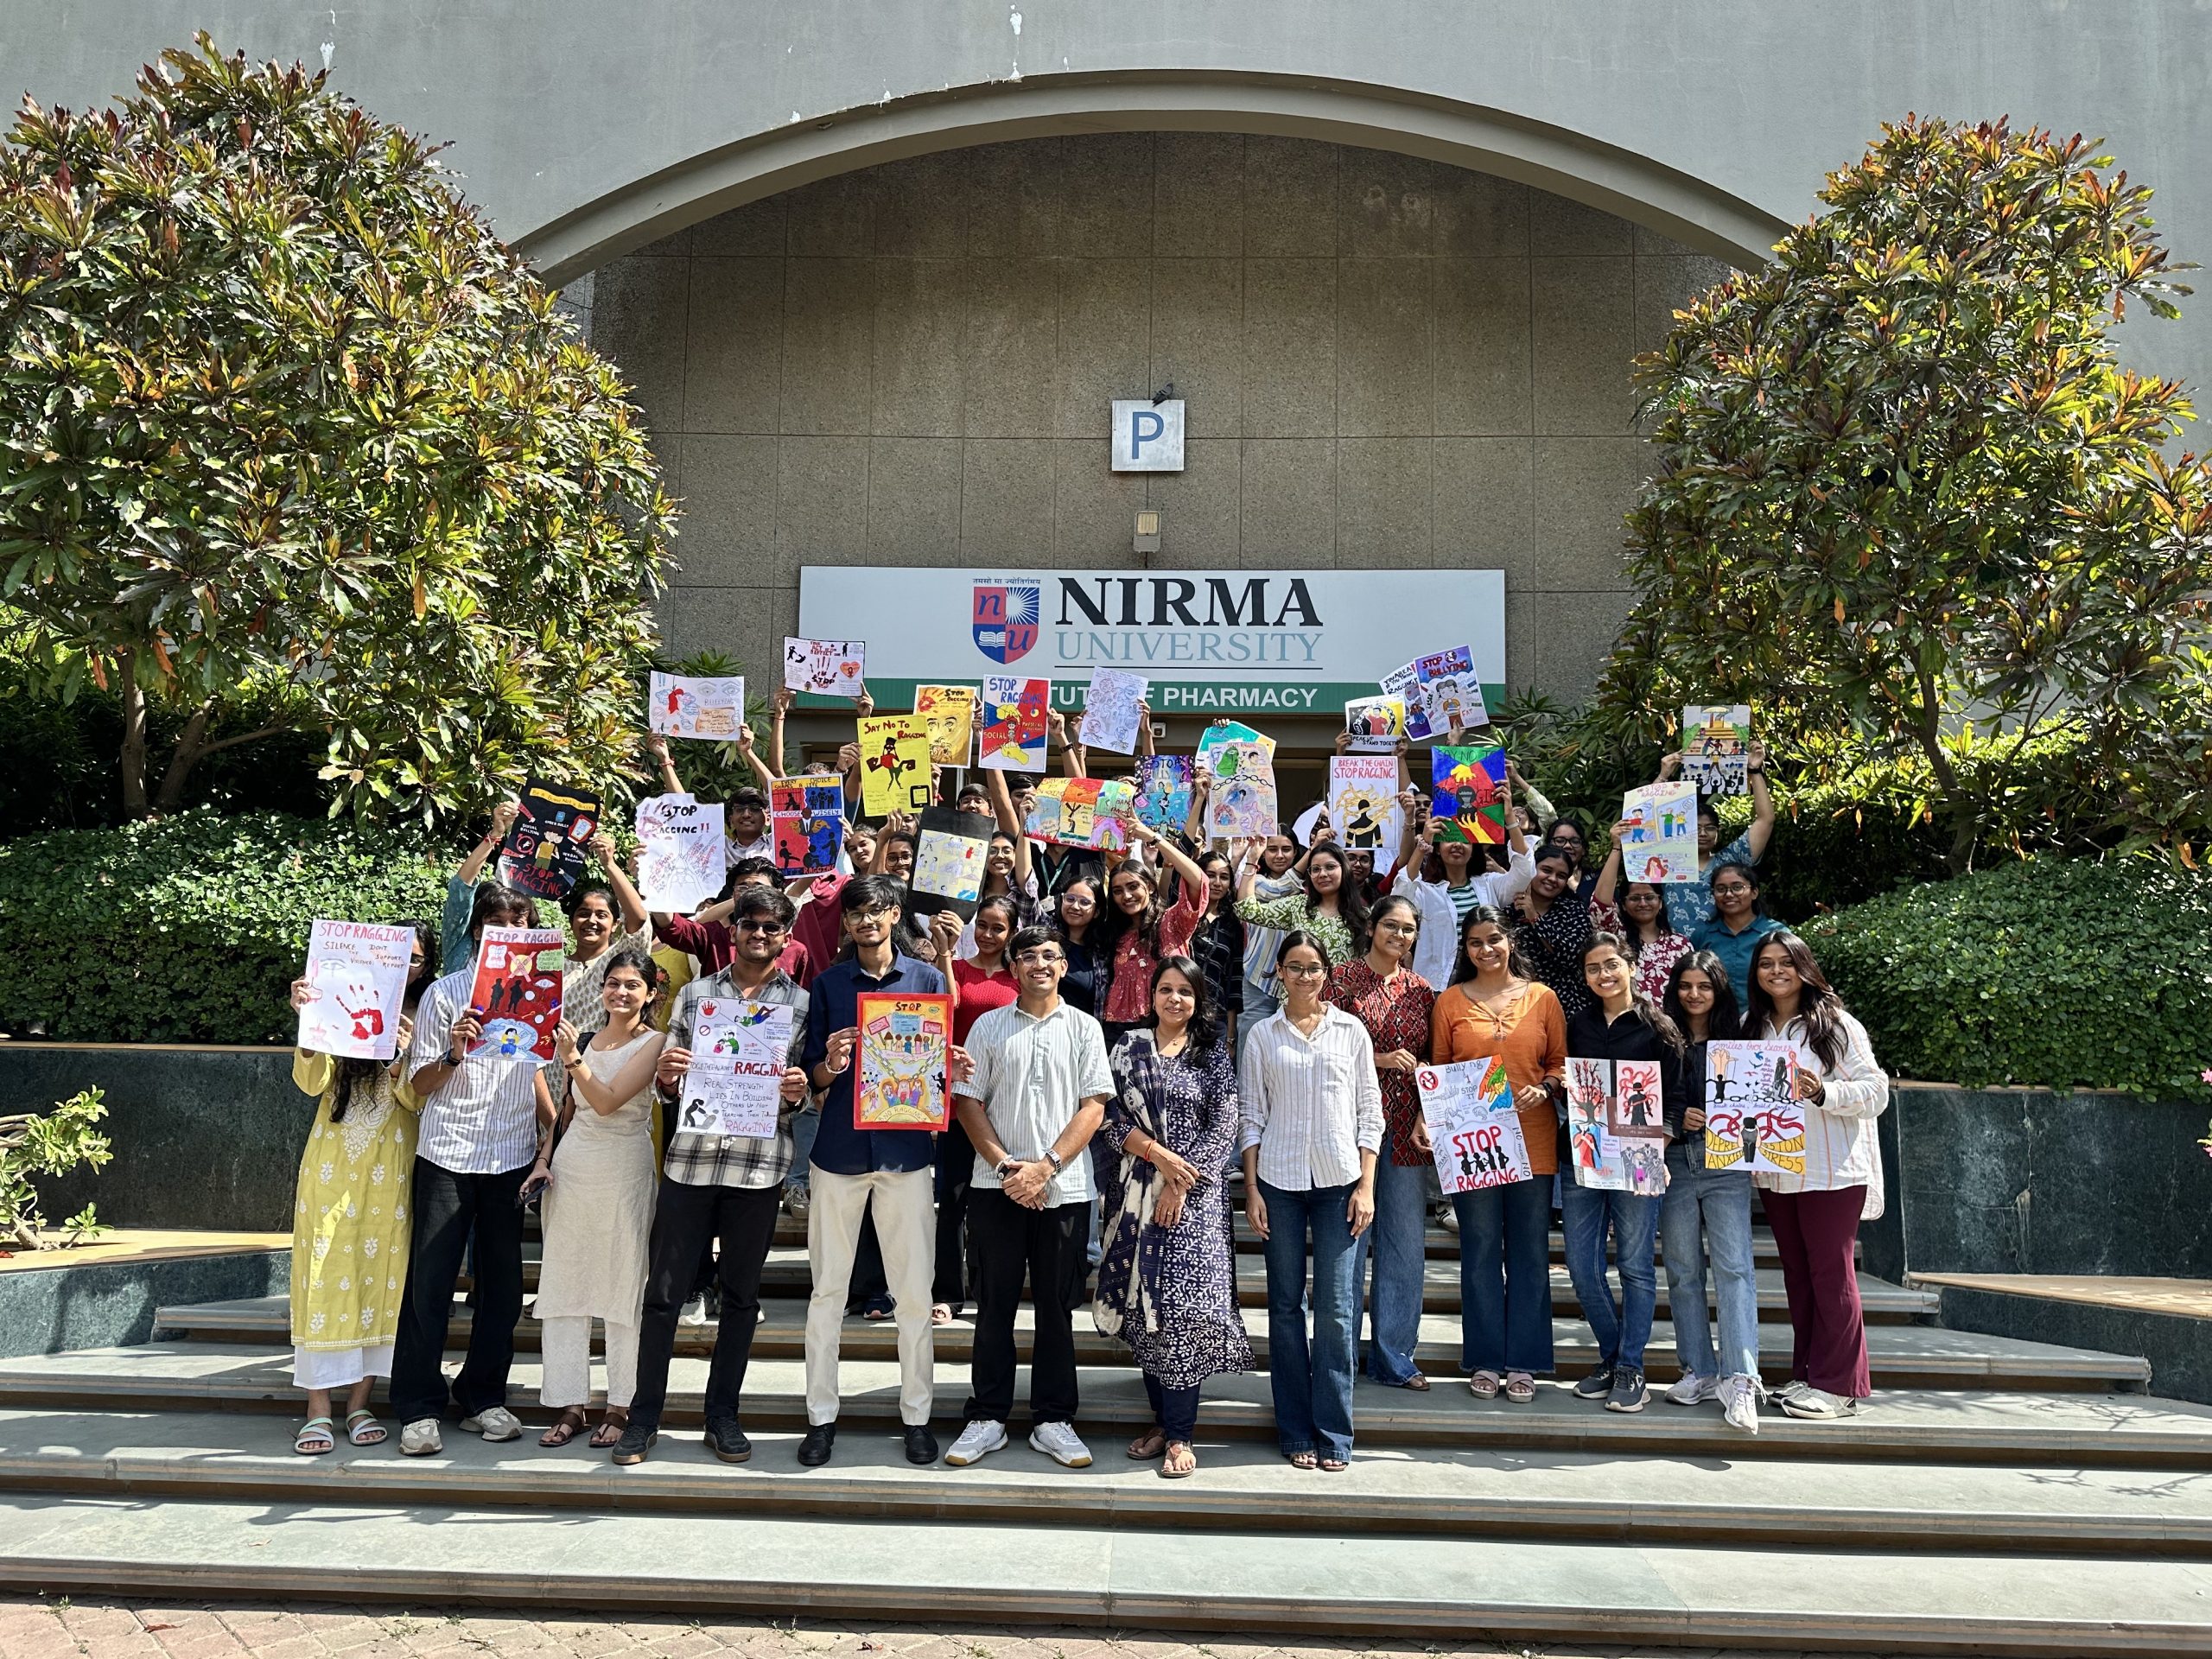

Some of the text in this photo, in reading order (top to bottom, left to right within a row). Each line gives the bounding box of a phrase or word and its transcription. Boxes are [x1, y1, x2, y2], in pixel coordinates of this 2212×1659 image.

[1132, 411, 1165, 460] P
[1055, 577, 1324, 626] NIRMA
[1054, 632, 1324, 662] UNIVERSITY
[1422, 656, 1442, 669] STOP
[1428, 660, 1469, 677] BULLYING
[988, 677, 1017, 691] STOP
[1387, 679, 1414, 695] RAGGING
[944, 689, 965, 697] STOP
[1001, 691, 1043, 704] RAGGING
[1163, 687, 1319, 708] PHARMACY
[1462, 709, 1472, 717] FAT
[864, 721, 880, 734] SAY
[897, 730, 926, 740] RAGGING
[983, 731, 1007, 740] SOCIAL
[1437, 750, 1459, 761] SAY
[1459, 749, 1478, 762] NO
[1338, 759, 1394, 767] BREAK THE CHAIN
[1334, 766, 1395, 779] STOP RAGGING
[1644, 783, 1668, 792] STOP
[661, 804, 698, 817] STOP
[523, 863, 555, 880] STOP
[803, 864, 836, 875] RAGGING
[507, 867, 563, 896] RAGGING
[318, 921, 408, 943] STOP RAGGING
[486, 931, 519, 942] STOP
[322, 941, 356, 950] SILENCE
[895, 1001, 922, 1012] STOP
[703, 1077, 764, 1090] REAL STRENGTH
[1461, 1084, 1478, 1095] STOP
[729, 1090, 740, 1100] IN
[724, 1120, 773, 1134] RAGGING
[1452, 1125, 1502, 1158] STOP
[1511, 1127, 1522, 1141] NO
[1521, 1161, 1531, 1177] NO
[1762, 1149, 1803, 1174] STRESS
[1456, 1167, 1521, 1192] RAGGING
